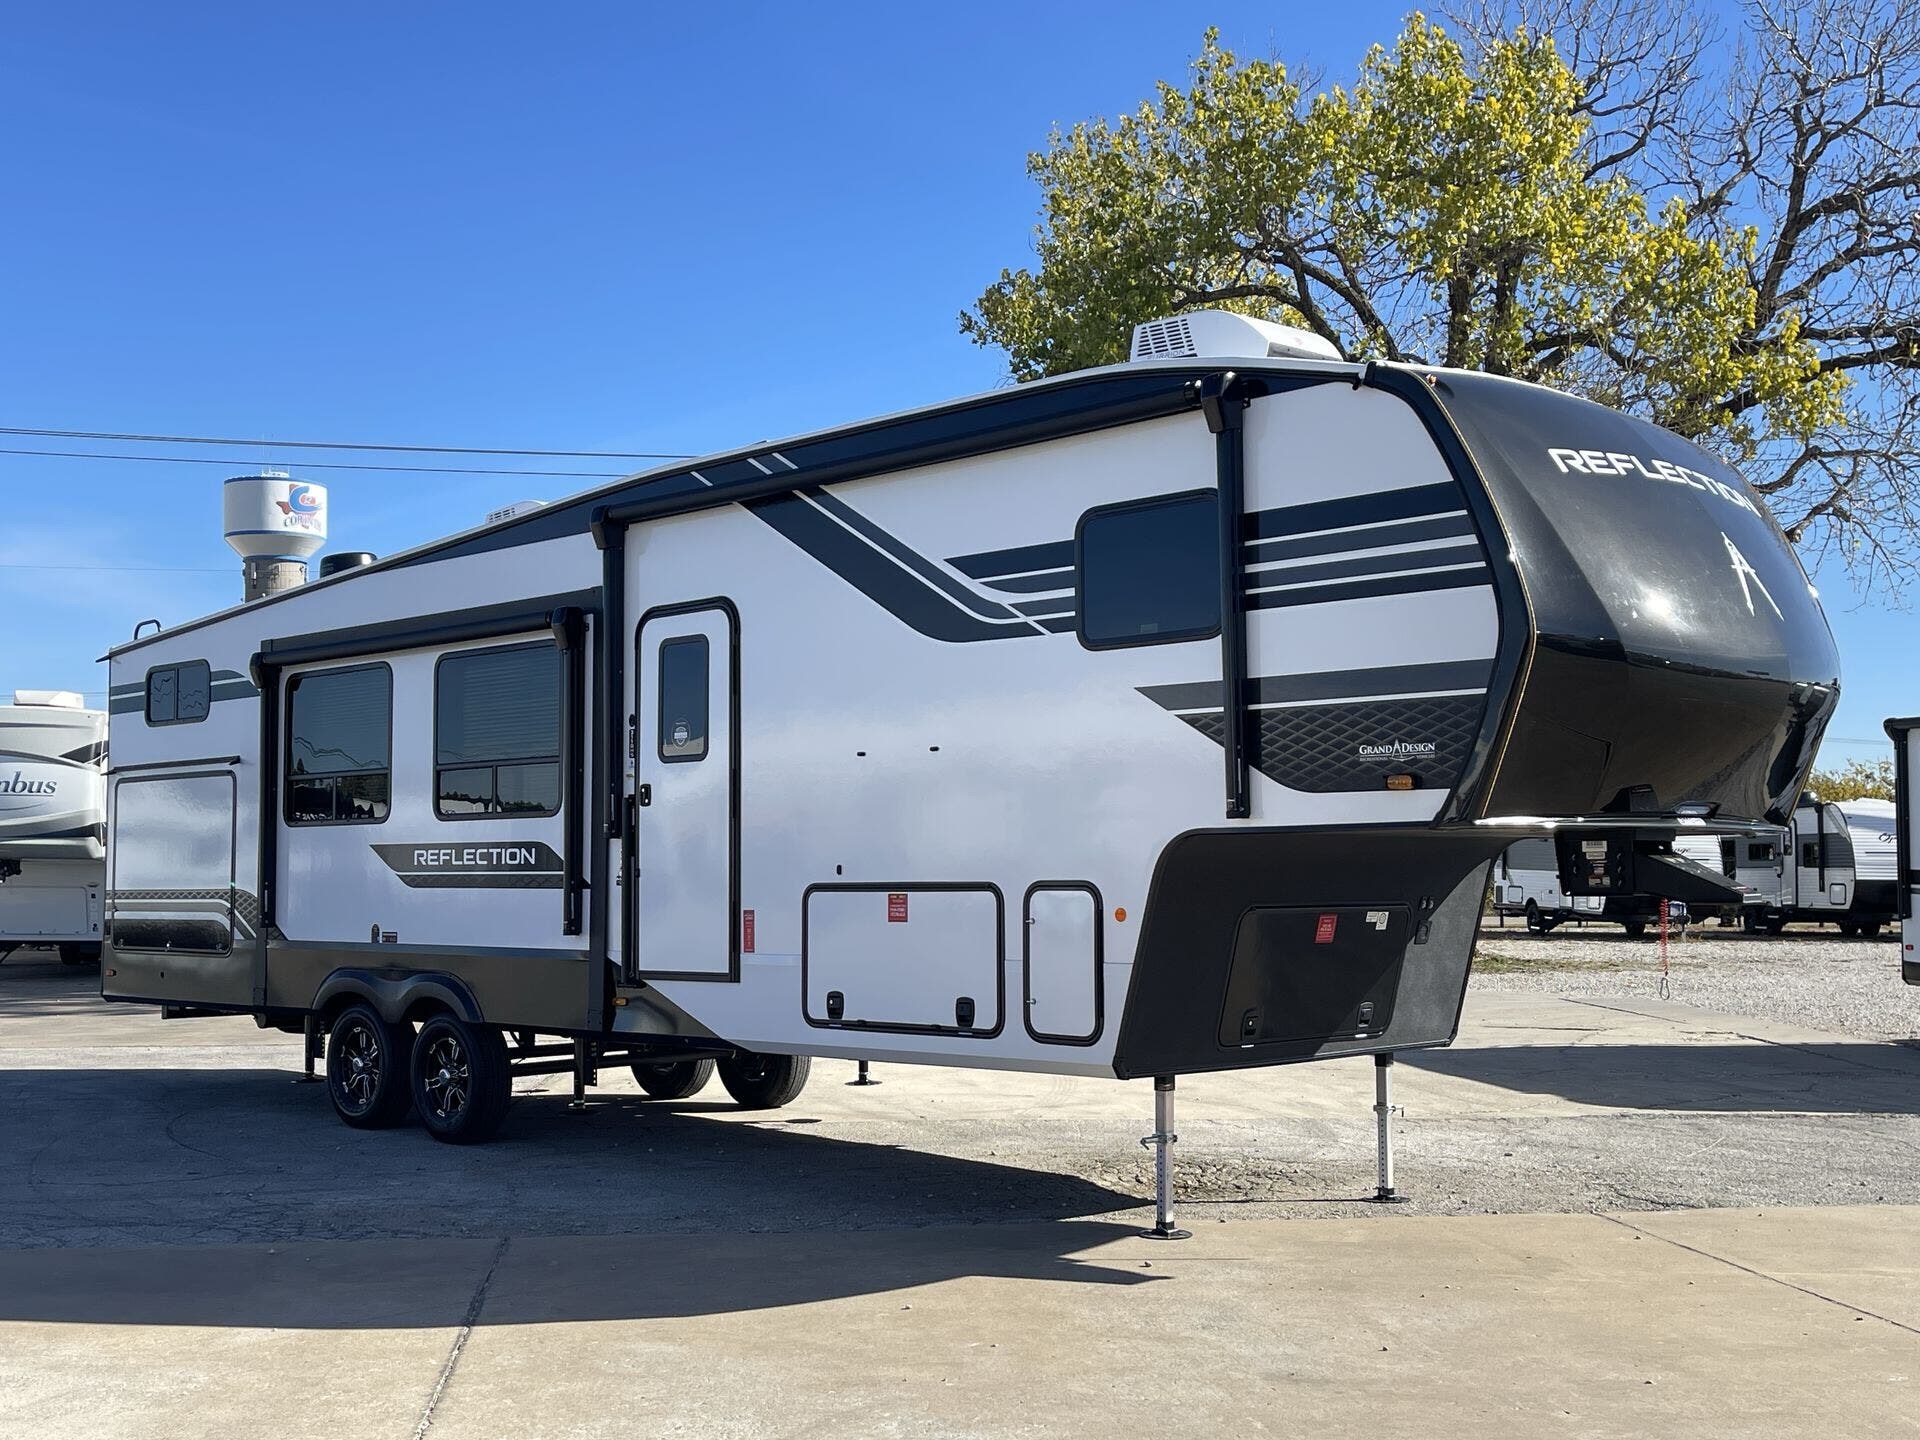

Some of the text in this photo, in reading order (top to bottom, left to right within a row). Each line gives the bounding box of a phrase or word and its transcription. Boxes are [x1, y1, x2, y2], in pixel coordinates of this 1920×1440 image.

[1547, 448, 1762, 517] REFLECTION
[1359, 742, 1436, 756] GRAND DESIGN
[413, 847, 537, 866] REFLECTION
